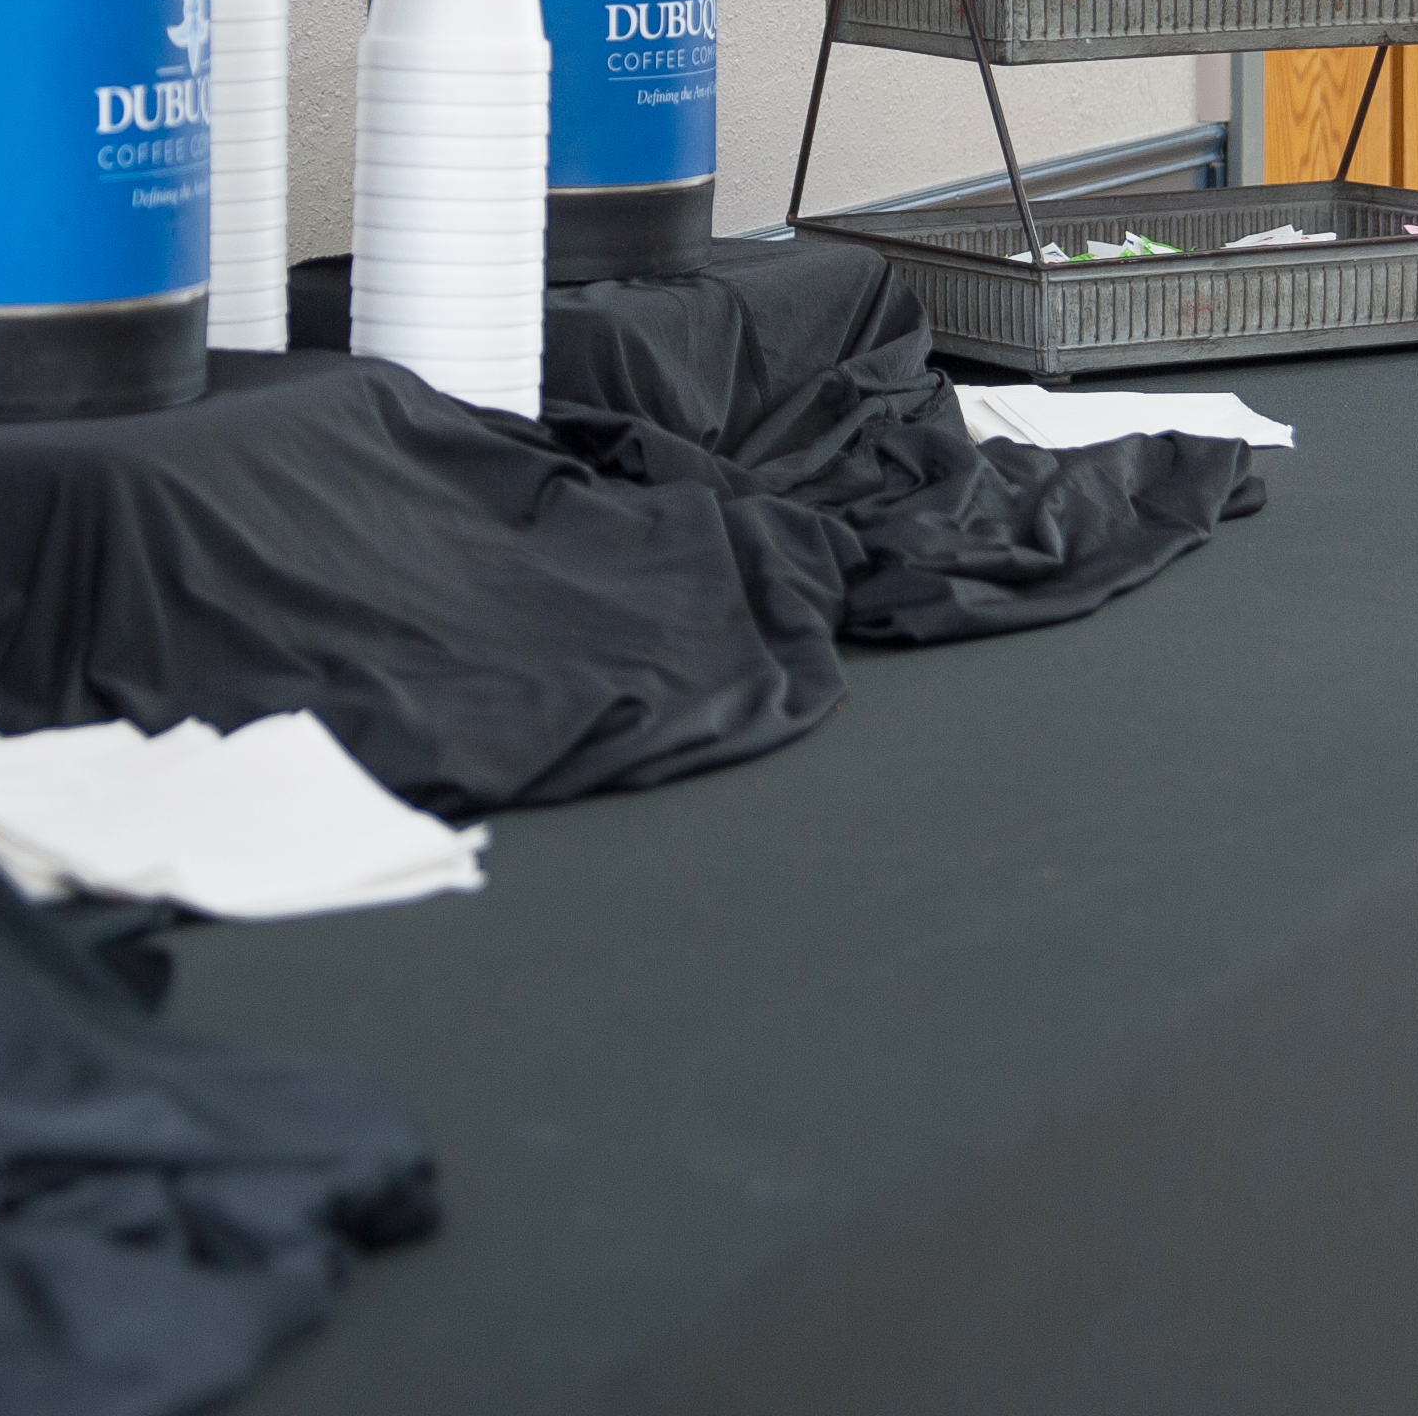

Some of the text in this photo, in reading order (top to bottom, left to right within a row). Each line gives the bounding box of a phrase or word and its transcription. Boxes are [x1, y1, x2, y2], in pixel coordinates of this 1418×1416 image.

[607, 48, 686, 72] COFFEE
[637, 87, 679, 106] Defining
[98, 137, 184, 170] COFFEE
